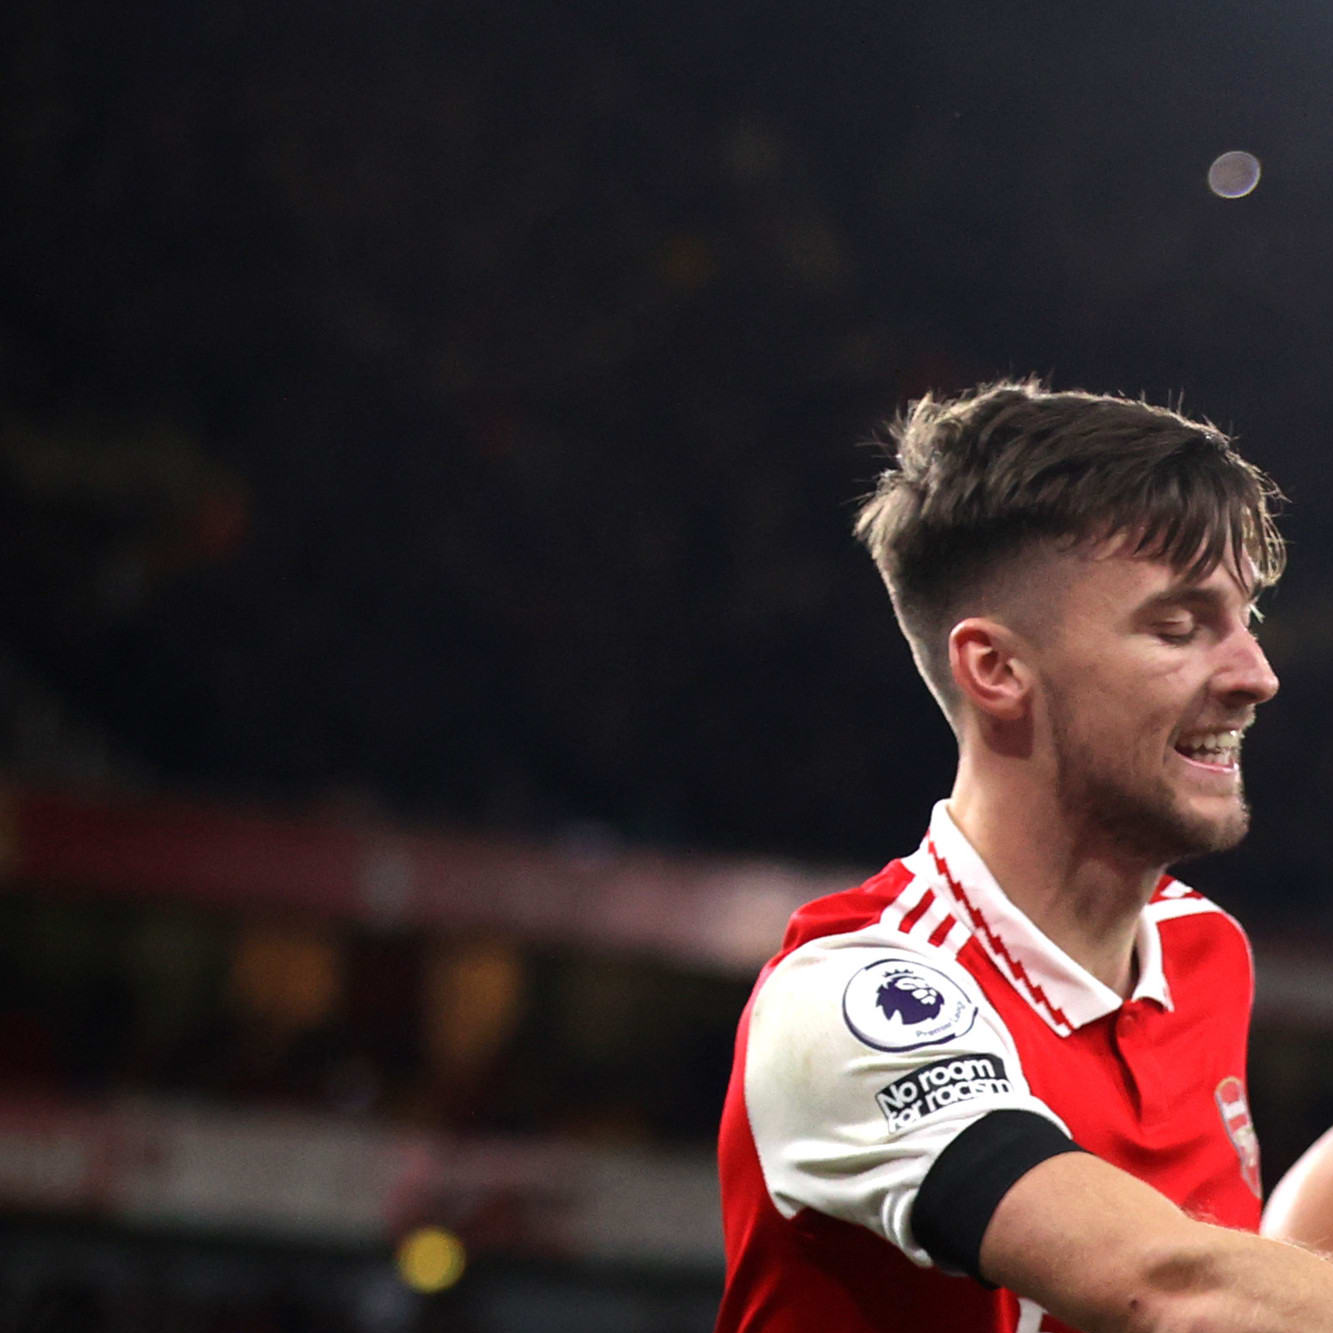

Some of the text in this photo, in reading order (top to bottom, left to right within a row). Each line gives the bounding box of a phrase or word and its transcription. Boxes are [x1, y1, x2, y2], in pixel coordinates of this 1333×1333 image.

[877, 1059, 995, 1117] No room
[925, 1079, 1013, 1112] racism
